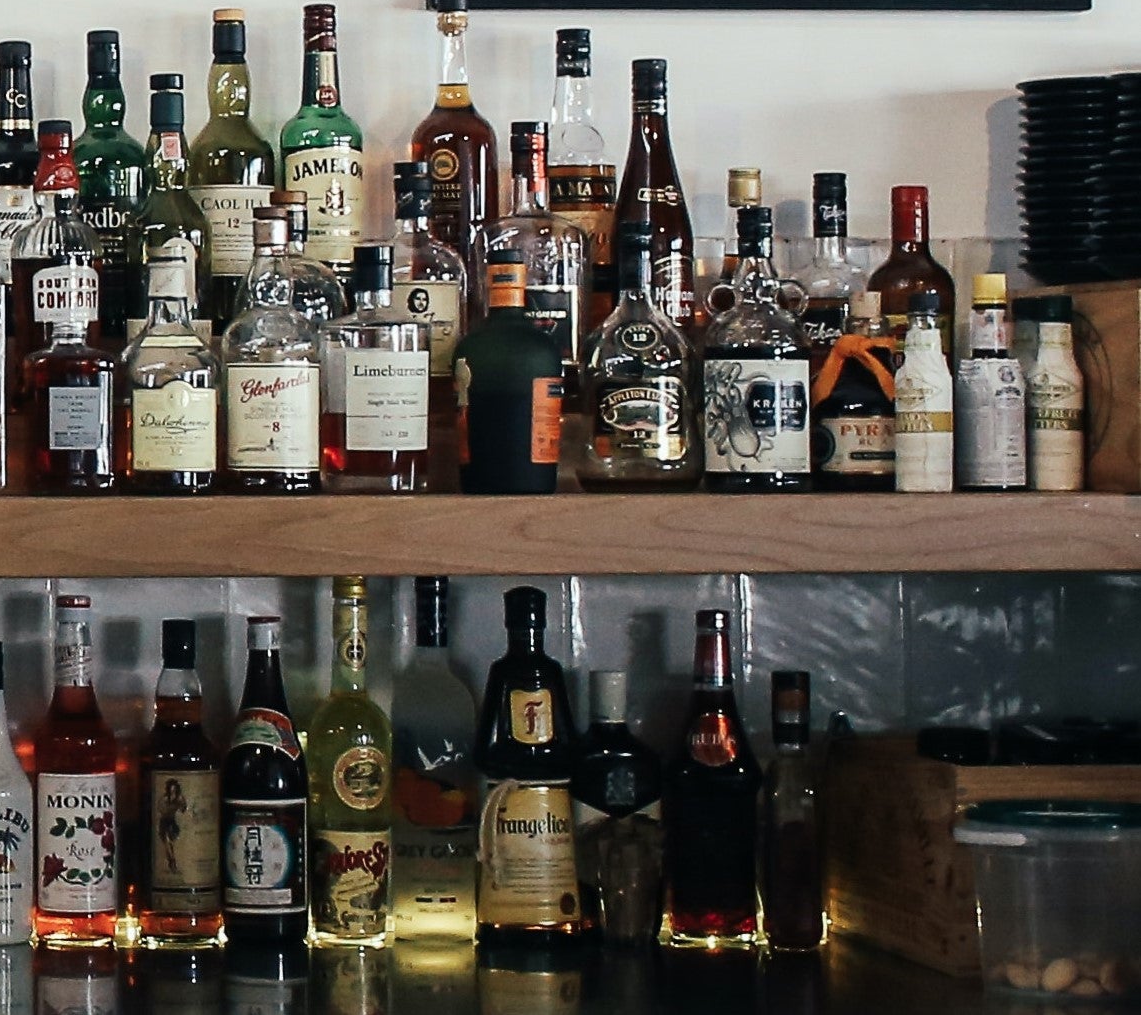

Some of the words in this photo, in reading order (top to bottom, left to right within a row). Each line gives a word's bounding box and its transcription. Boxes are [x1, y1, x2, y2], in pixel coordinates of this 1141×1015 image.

[200, 197, 240, 210] CAOL
[226, 218, 241, 229] 12
[271, 421, 281, 433] 8
[46, 794, 113, 809] MONIN
